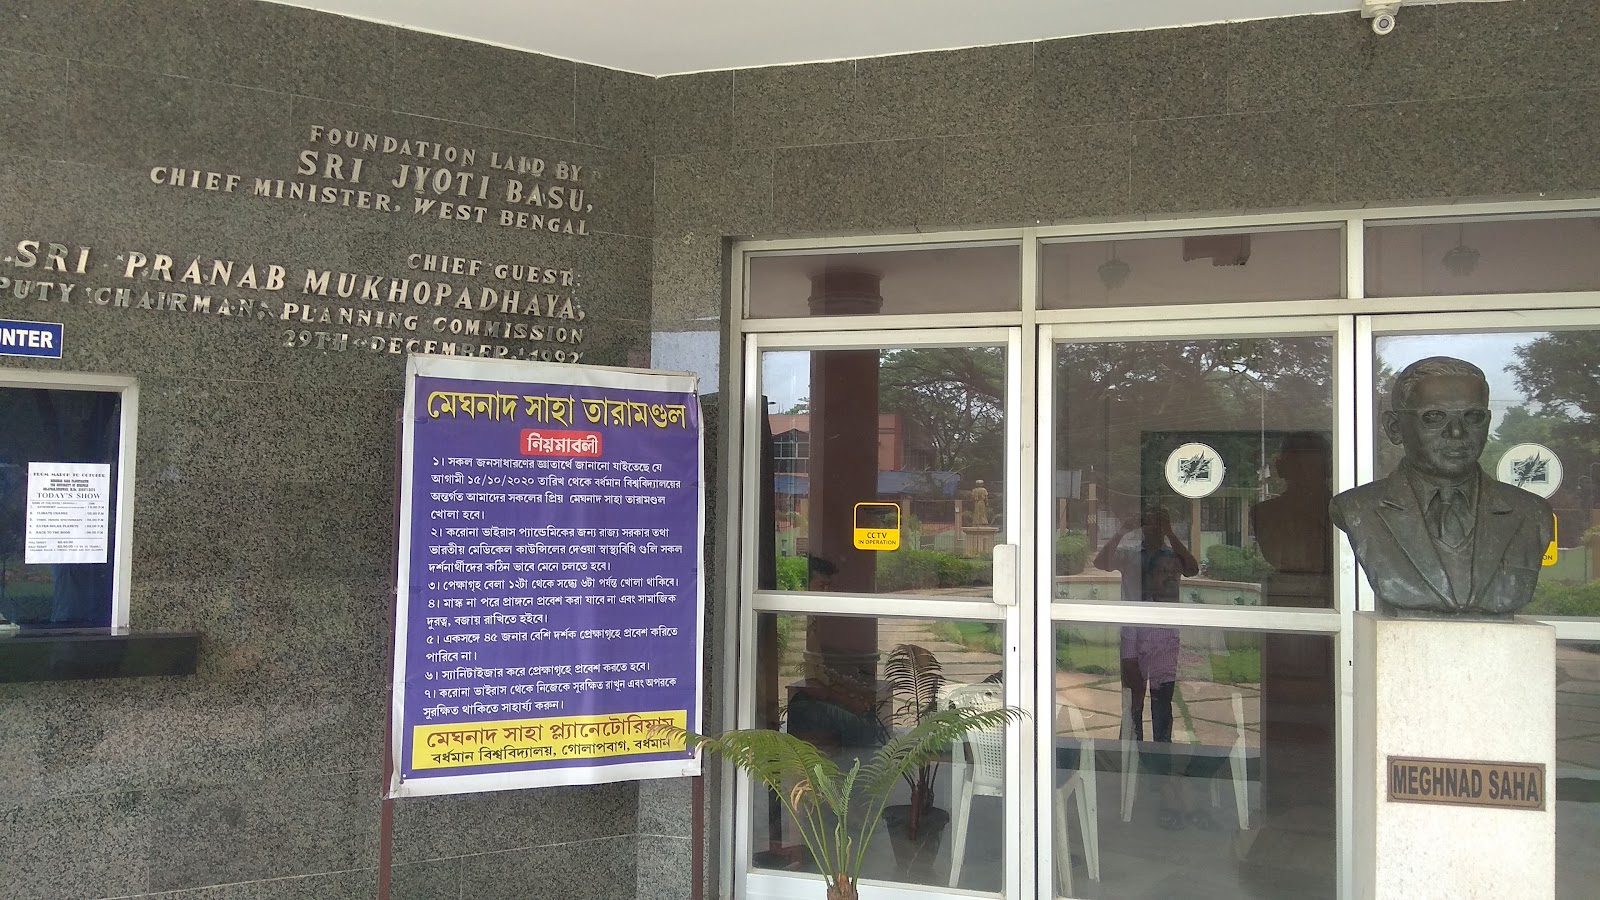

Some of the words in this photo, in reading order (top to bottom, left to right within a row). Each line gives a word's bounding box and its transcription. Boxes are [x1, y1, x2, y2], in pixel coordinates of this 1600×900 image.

[309, 124, 476, 167] FOUNDATION
[490, 151, 545, 177] LAID
[556, 161, 583, 182] BY
[297, 149, 364, 184] SRI
[391, 164, 491, 201] JYOTI
[506, 178, 594, 213] BASU,
[150, 166, 241, 193] CHIEF
[254, 177, 401, 213] MINISTER,
[414, 197, 488, 224] WEST
[500, 209, 590, 236] BENGAL
[407, 253, 483, 277] CHIEF
[123, 251, 286, 292] PRANAB
[302, 268, 586, 322] MUKHOPADHAYA,
[282, 302, 418, 331] PLANNING
[433, 316, 584, 345] COMMISSION
[0, 328, 53, 349] NTER
[283, 329, 349, 351] 29TH
[427, 391, 518, 423] মেঘনাদ
[524, 393, 576, 428] সাহা
[582, 395, 687, 430] তারামণ্ডল
[527, 432, 599, 455] নিয়মাবলী
[448, 458, 473, 467] সকল
[476, 459, 534, 468] জনসাধারণের
[575, 461, 610, 470] জানানো
[613, 461, 650, 473] যাইতেছে
[652, 464, 662, 472] যে
[431, 472, 464, 484] আগামী
[468, 475, 534, 486] ১৫/১০/২০২০
[538, 474, 564, 486] তারিখ
[568, 477, 592, 486] থেকে
[594, 476, 620, 487] বর্ধমান
[430, 490, 464, 502] অন্তর্গত
[466, 493, 505, 502] আমাদের
[508, 494, 542, 502] সকলের
[545, 491, 563, 503] প্রিয়
[570, 494, 602, 503] মেঘনাদ
[604, 495, 622, 505] সাহা
[431, 509, 459, 519] খোলা
[445, 528, 479, 537] করোনা
[482, 526, 516, 538] ভাইরাস
[577, 529, 596, 537] জন্য
[599, 528, 619, 537] রাজ্য
[622, 528, 649, 537] সরকার
[652, 528, 669, 537] তথা
[429, 542, 465, 555] ভারতীয়
[469, 542, 512, 555] মেডিকেল
[569, 545, 596, 554] দেওয়া
[639, 542, 658, 554] গুলি
[428, 560, 483, 572] দর্শনার্থীদের
[485, 559, 510, 572] কঠিন
[513, 562, 534, 571] ভাবে
[538, 563, 559, 571] মেনে
[561, 562, 588, 571] চলতে
[484, 580, 505, 589] বেলা
[509, 578, 528, 589] ১২টা
[532, 579, 555, 589] থেকে
[581, 576, 595, 587] ৬টা
[599, 576, 617, 588] পর্যন্ত
[621, 578, 643, 587] খোলা
[443, 598, 463, 608] মাস্ক
[466, 598, 477, 607] না
[481, 597, 499, 607] পরে
[537, 596, 563, 605] প্রবেশ
[565, 595, 582, 605] করা
[585, 595, 604, 604] যাবে
[607, 595, 616, 604] না
[638, 592, 676, 603] সামাজিক
[454, 616, 481, 625] বজায়
[483, 613, 517, 624] রাখিতে
[484, 633, 497, 642] ৪৫
[501, 632, 527, 641] জনার
[530, 628, 551, 641] বেশি
[553, 627, 577, 640] দর্শক
[580, 629, 621, 640] প্রেক্ষাগৃহে
[624, 628, 648, 637] প্রবেশ
[650, 625, 678, 636] করিতে
[426, 649, 458, 662] পারিবে
[442, 667, 503, 680] স্যানিটাইজার
[505, 668, 525, 676] করে
[529, 665, 572, 677] প্রেক্ষাগৃহে
[575, 664, 600, 673] প্রবেশ
[602, 663, 627, 672] করতে
[439, 687, 470, 698] করোনা
[474, 684, 507, 696] ভাইরাস
[510, 684, 534, 694] থেকে
[536, 681, 571, 693] নিজেকে
[573, 679, 603, 693] সুরক্ষিত
[605, 680, 625, 691] রাখুন
[628, 680, 644, 688] এবং
[645, 678, 677, 687] অপরকে
[423, 704, 459, 719] সুরক্ষিত
[462, 702, 499, 714] থাকিতে
[427, 728, 498, 748] মেঘনাদ
[502, 724, 544, 743] সাহা
[431, 749, 474, 764] বর্ধমান
[1393, 764, 1483, 799] MEGHNAD
[1488, 770, 1539, 802] SAHA
